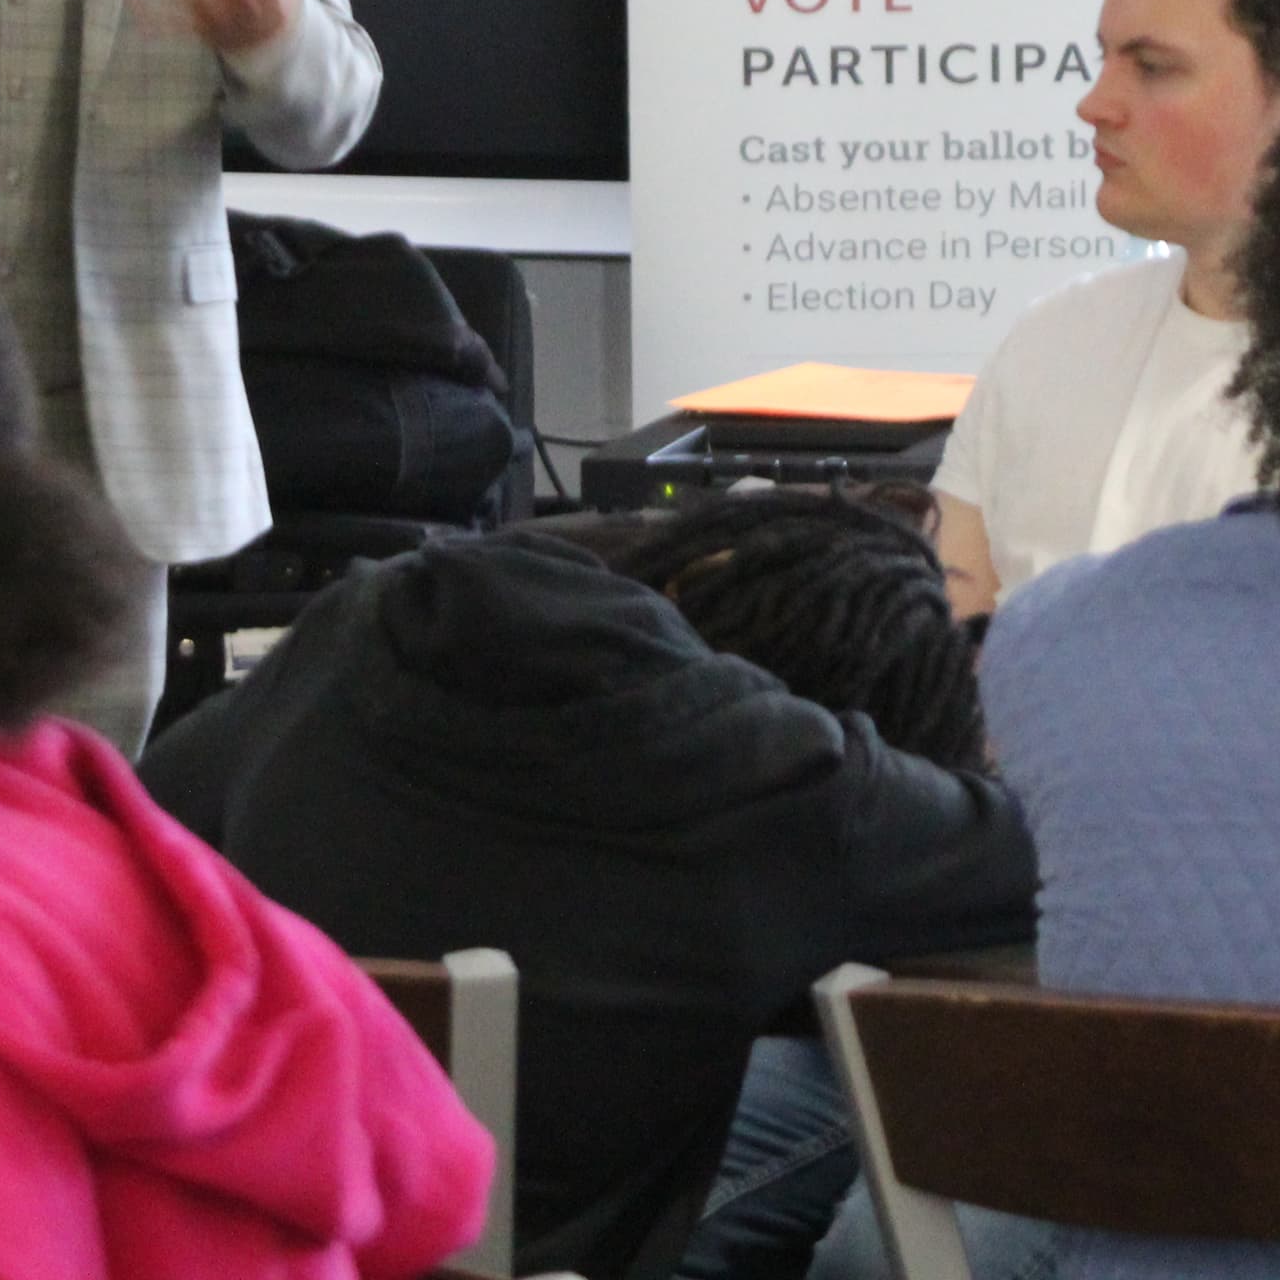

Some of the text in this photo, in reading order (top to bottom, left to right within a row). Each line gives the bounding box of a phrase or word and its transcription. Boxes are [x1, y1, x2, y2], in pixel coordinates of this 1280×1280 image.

[739, 135, 826, 164] Cast
[841, 139, 929, 169] your
[942, 131, 1055, 162] ballot
[766, 179, 1087, 216] Absentee by Mail
[766, 230, 1116, 262] Advance in Person
[768, 281, 997, 315] Election Day
